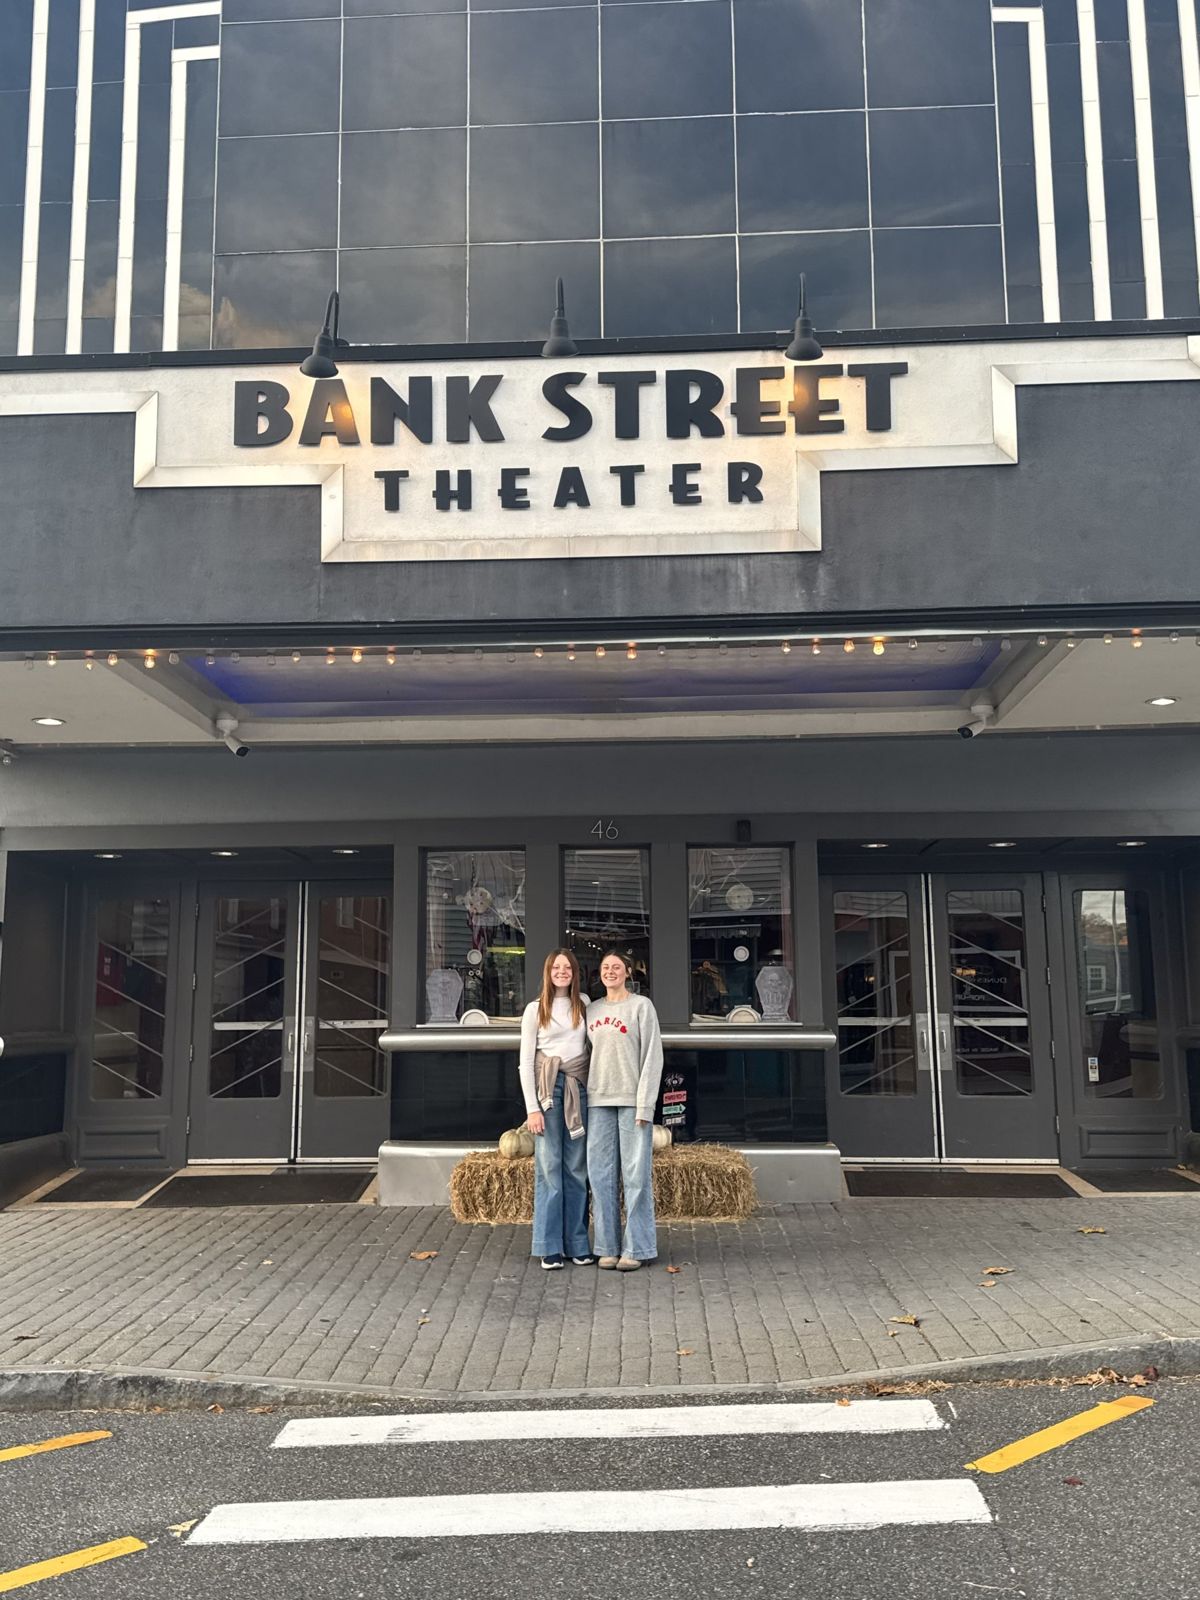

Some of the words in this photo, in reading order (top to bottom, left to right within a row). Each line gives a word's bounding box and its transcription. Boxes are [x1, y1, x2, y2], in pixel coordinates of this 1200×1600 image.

[234, 374, 505, 446] BANK
[541, 362, 908, 441] STREET
[374, 462, 764, 512] THEATER
[591, 820, 619, 839] 46
[590, 1017, 622, 1032] PARIS
